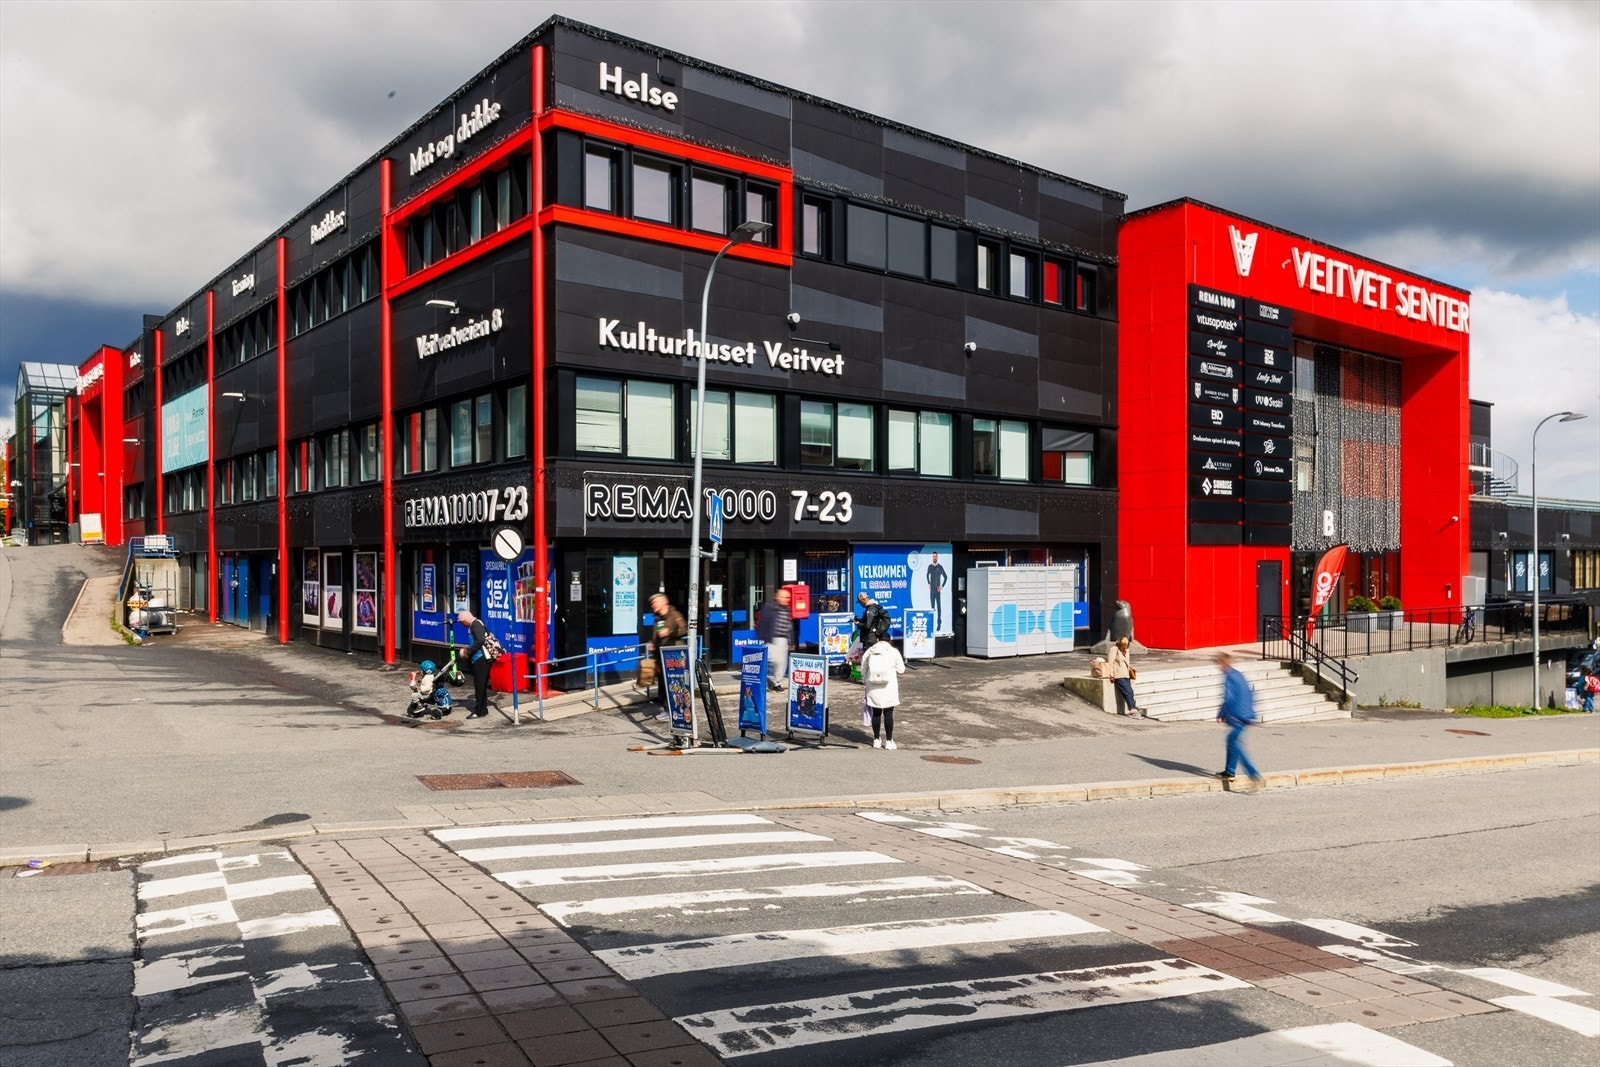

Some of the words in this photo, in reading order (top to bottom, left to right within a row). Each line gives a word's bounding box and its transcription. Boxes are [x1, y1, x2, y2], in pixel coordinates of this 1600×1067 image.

[600, 62, 679, 110] Helse
[409, 143, 434, 176] Mat
[436, 134, 454, 158] og
[457, 98, 501, 144] drikke
[310, 210, 345, 245] Butikker
[1198, 290, 1220, 306] REMA
[1220, 295, 1236, 309] 1000
[1291, 246, 1392, 310] VEITVET
[1395, 282, 1470, 334] SENTER
[416, 318, 489, 359] Veitvetveien
[492, 308, 503, 332] 8
[599, 317, 757, 365] Kulturhuset
[763, 340, 845, 375] Veitvet
[404, 495, 450, 528] REMA
[448, 491, 488, 526] 1000
[487, 486, 529, 523] 7-23
[585, 483, 694, 520] REMA
[702, 487, 778, 522] 1000
[790, 490, 854, 524] 7-23
[1323, 510, 1334, 536] B
[858, 564, 907, 579] VELKOMMEN
[869, 580, 890, 589] REMA
[891, 580, 907, 589] 1000
[1315, 571, 1332, 606] EKO
[487, 578, 494, 609] 3
[494, 579, 503, 608] FOR
[874, 590, 892, 599] VEITVET
[793, 659, 803, 668] PEPSI
[804, 660, 814, 668] MAX
